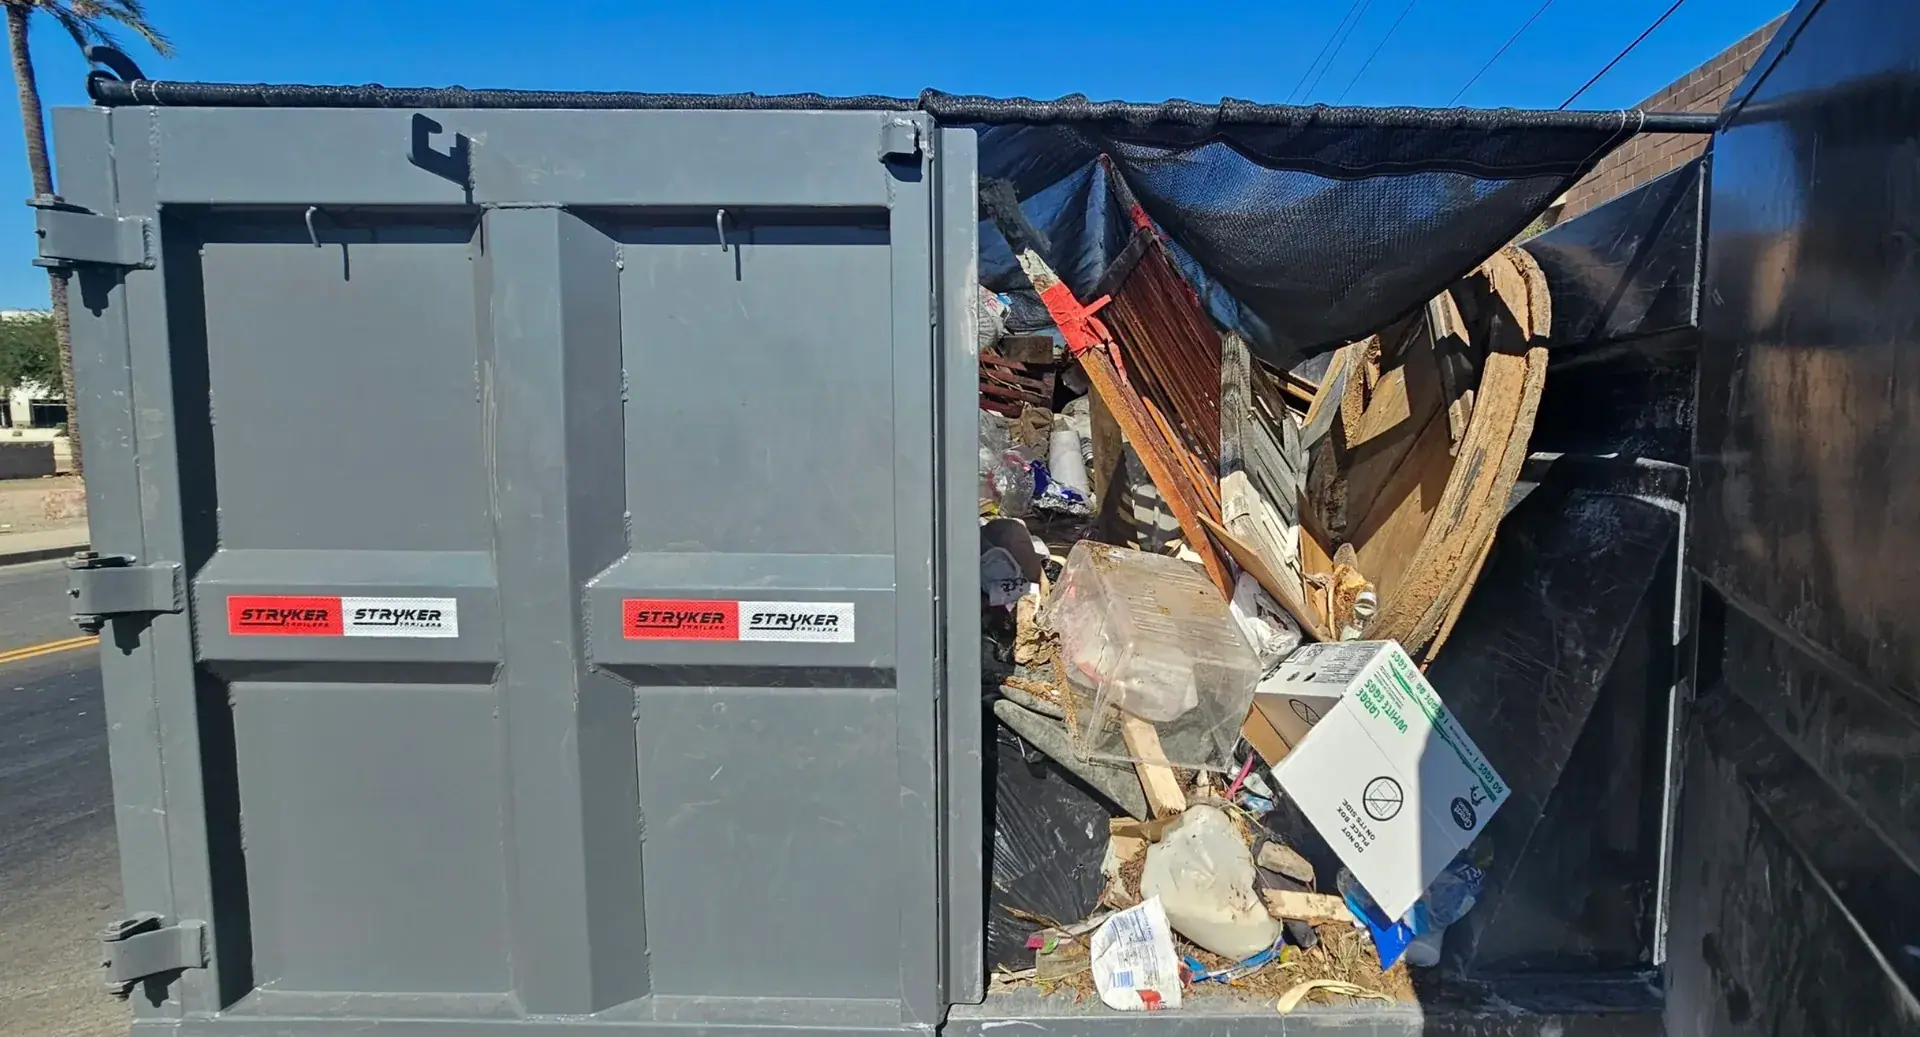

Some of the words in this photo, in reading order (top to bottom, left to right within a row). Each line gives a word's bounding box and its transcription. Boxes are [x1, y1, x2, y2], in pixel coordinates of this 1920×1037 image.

[240, 608, 328, 623] STRYKER
[355, 608, 442, 623] STRYKER
[636, 611, 725, 626] STRYKER
[751, 613, 839, 628] STRYKER
[1391, 650, 1408, 671] EGGS
[1364, 678, 1385, 703] EGGS
[1355, 687, 1380, 719] LARGE
[1424, 694, 1445, 720] GRADE
[1381, 700, 1408, 734] WHITE
[1478, 763, 1495, 783] EGGS
[1492, 782, 1504, 794] 60
[1336, 806, 1350, 823] BOX
[1454, 803, 1473, 828] Great
[1356, 816, 1367, 830] ITS
[1341, 827, 1355, 842] NOT
[1350, 823, 1370, 847] PLACE
[1366, 829, 1376, 841] ON
[1354, 841, 1364, 853] DO
